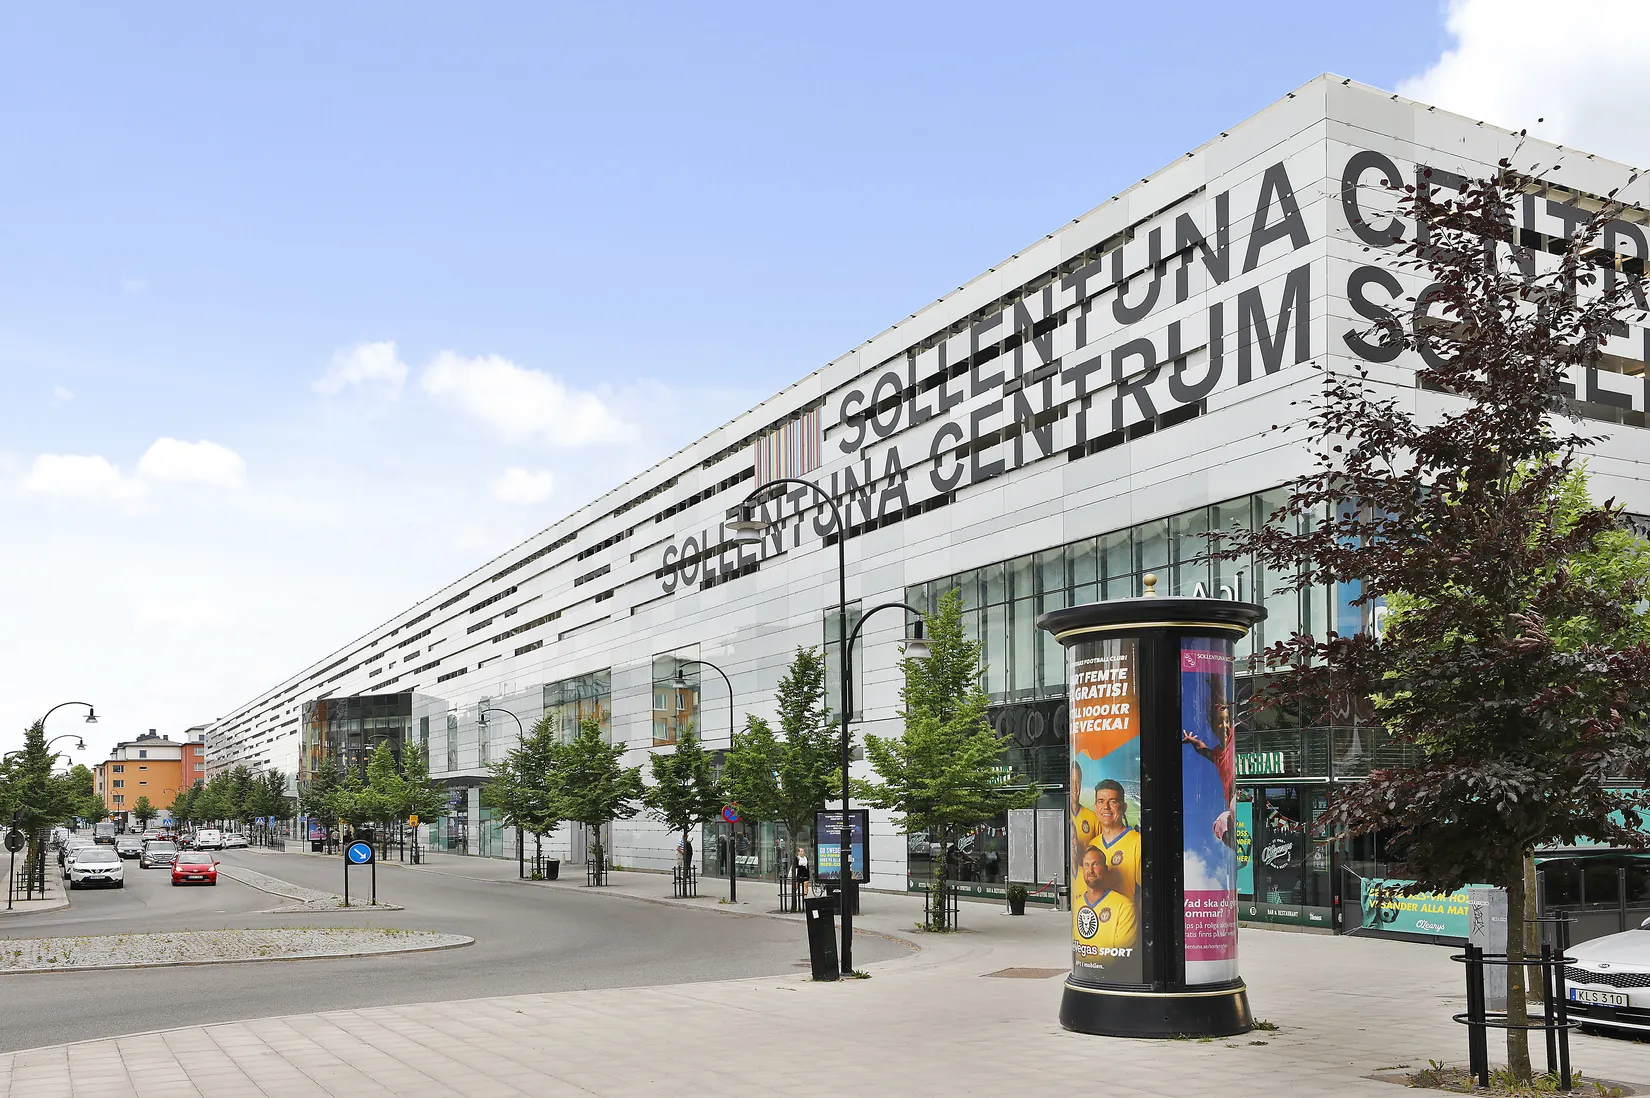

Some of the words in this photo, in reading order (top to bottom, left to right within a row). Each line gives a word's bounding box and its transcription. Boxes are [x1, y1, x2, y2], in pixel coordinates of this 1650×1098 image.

[838, 161, 1311, 454] SOLLENTUNA
[661, 444, 911, 594] SOLLENTUNA
[929, 262, 1311, 493] CENTRUM
[1109, 654, 1128, 662] CLUB!
[1085, 667, 1128, 684] FEMTE
[1075, 682, 1128, 701] GRATIS!
[1082, 704, 1110, 718] 1000
[1110, 703, 1130, 715] KR
[1079, 717, 1130, 733] VECKA!
[1203, 898, 1219, 908] ska
[1220, 898, 1229, 908] du
[1420, 903, 1445, 914] ALLA
[1447, 905, 1469, 916] MAT
[1195, 921, 1203, 931] på
[1416, 919, 1445, 932] O'Learys
[1099, 947, 1133, 958] SPORT
[1579, 990, 1598, 1002] KLS
[1601, 993, 1623, 1005] 310
